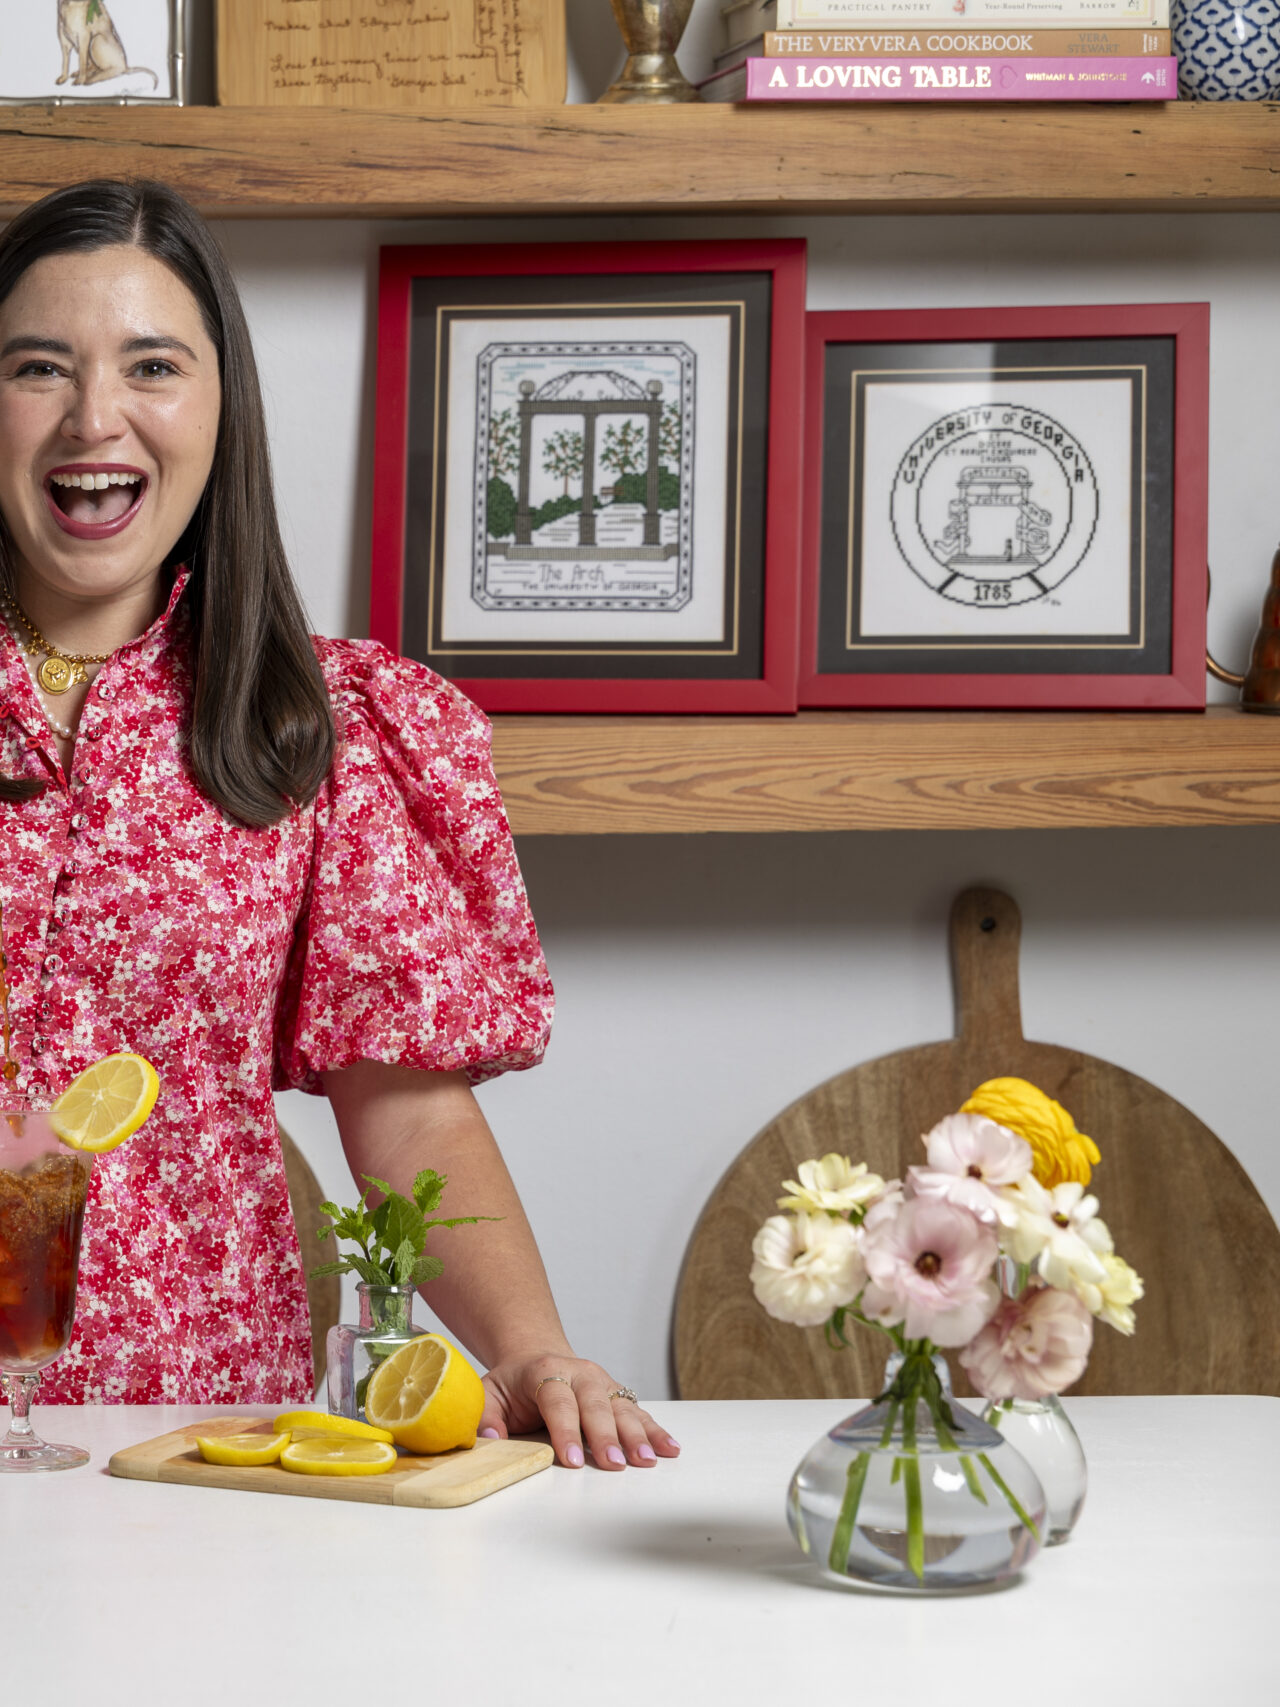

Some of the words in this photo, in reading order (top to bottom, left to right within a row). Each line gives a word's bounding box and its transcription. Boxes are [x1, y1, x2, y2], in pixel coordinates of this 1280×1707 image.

[827, 4, 886, 12] PRACTICAL
[891, 4, 932, 12] PANTRY
[1026, 3, 1064, 13] Preserving
[773, 35, 814, 52] THE
[926, 34, 1034, 52] COOKBOOK
[1078, 33, 1109, 43] VERA
[1067, 43, 1120, 54] STEWART
[768, 65, 789, 88] A
[796, 65, 903, 88] LOVING
[909, 65, 992, 89] TABLE
[1024, 72, 1066, 82] WHITMAN
[1068, 73, 1075, 82] &
[903, 410, 993, 484] UNIVERSITY
[1001, 412, 1018, 425] OF
[1020, 415, 1085, 484] GEORGIA
[538, 563, 563, 583] The
[572, 563, 606, 583] Arch
[973, 584, 1012, 601] 1785
